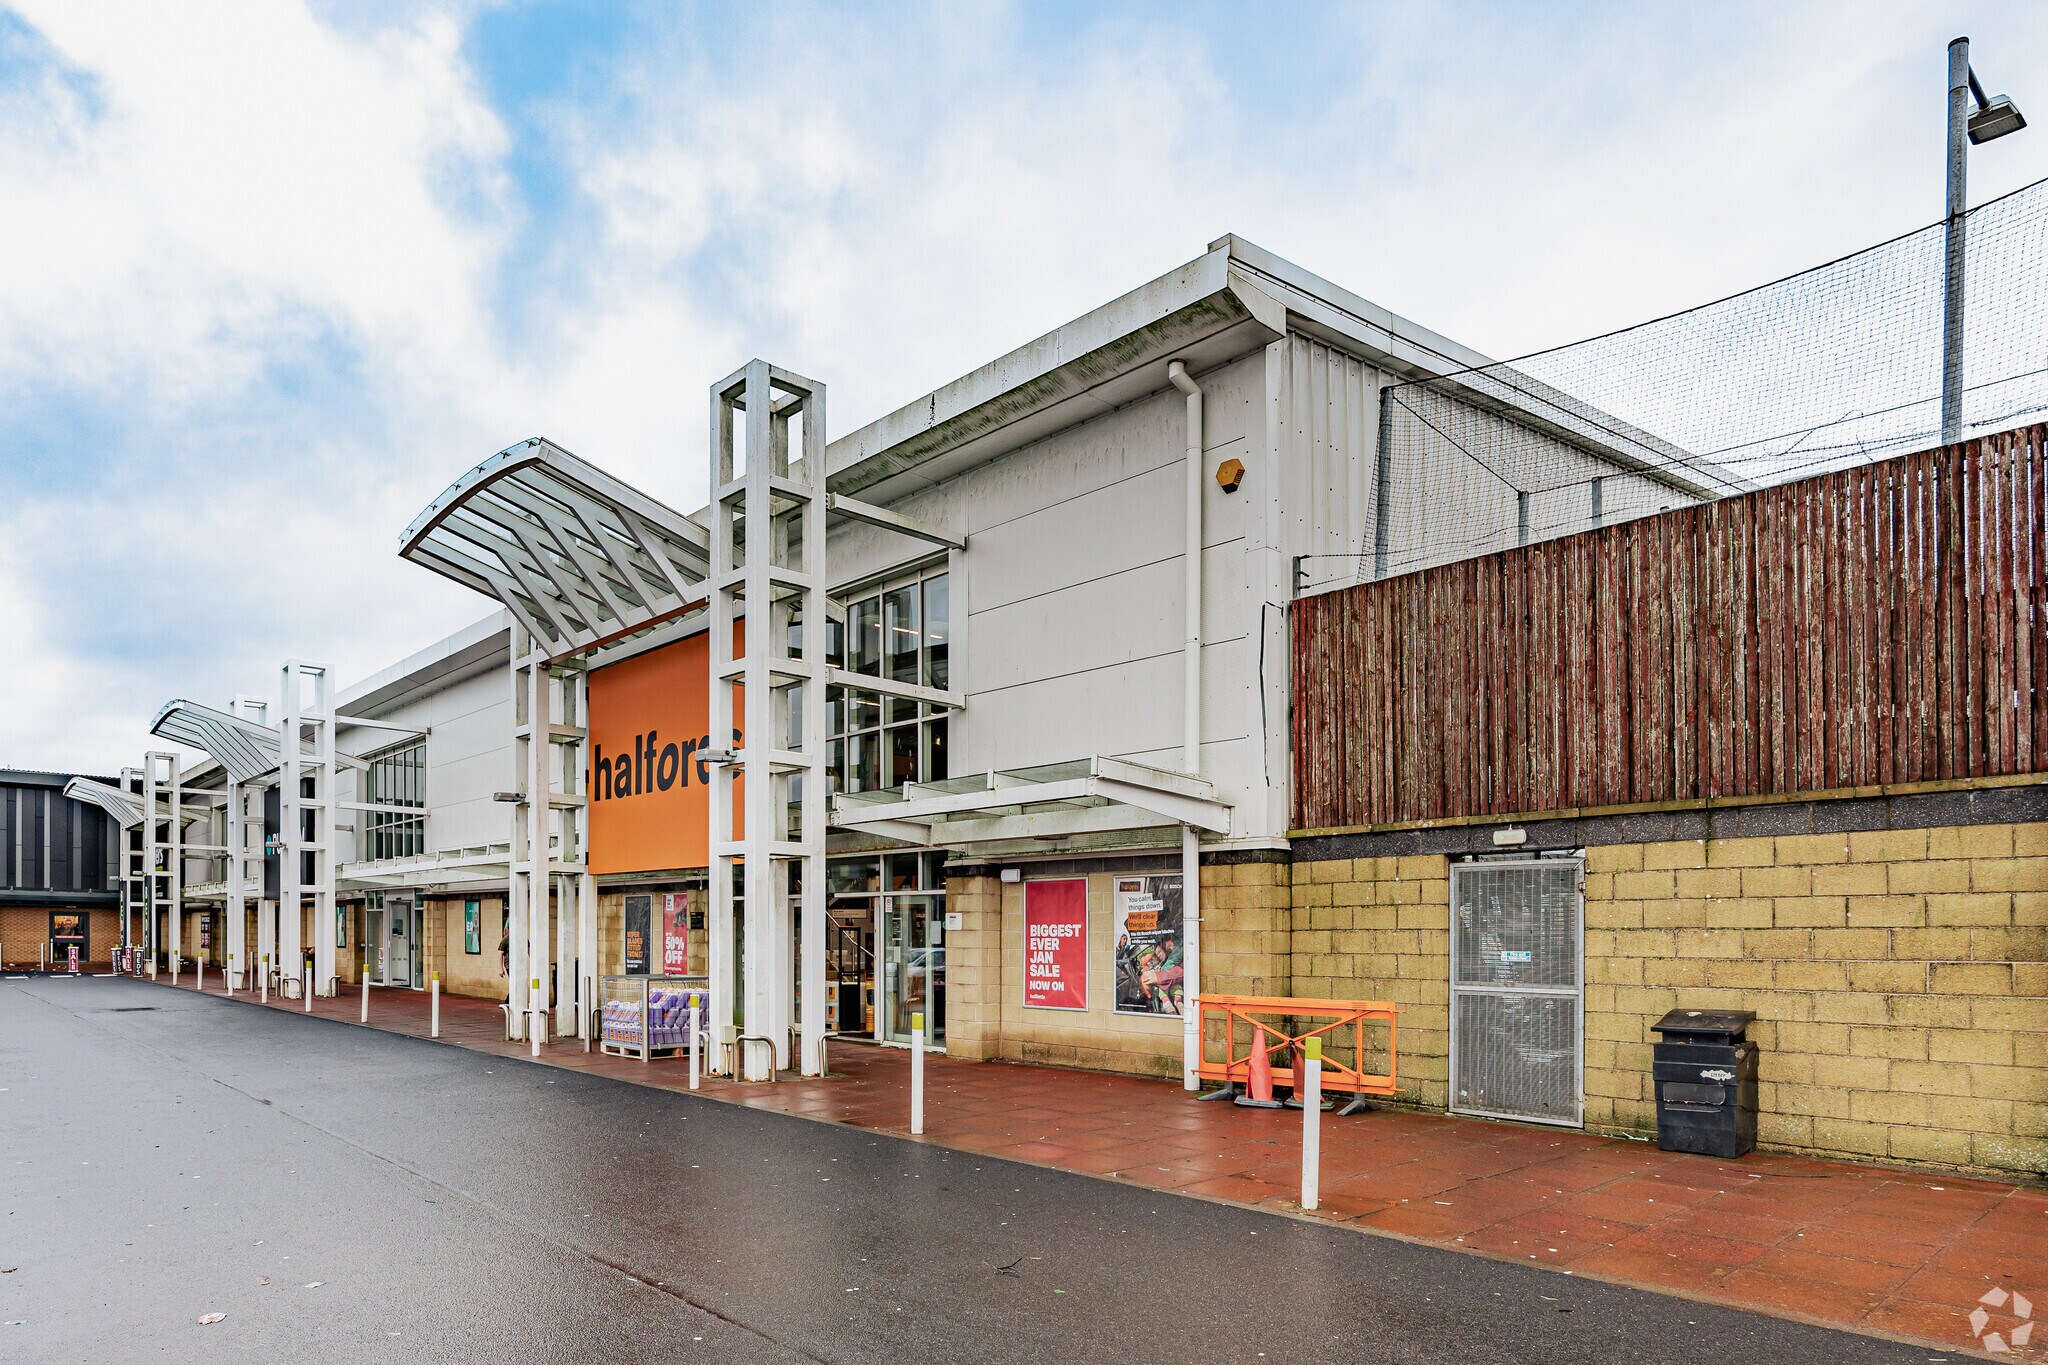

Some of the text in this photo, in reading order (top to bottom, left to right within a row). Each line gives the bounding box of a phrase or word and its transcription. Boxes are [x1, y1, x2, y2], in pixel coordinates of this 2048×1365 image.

[1030, 924, 1081, 937] BIGGEST
[665, 936, 685, 950] 50%
[1030, 938, 1060, 951] EVER
[665, 950, 683, 964] OFF
[1030, 951, 1053, 964] JAN
[1030, 964, 1060, 977] SALE
[1030, 980, 1064, 991] NOW ON
